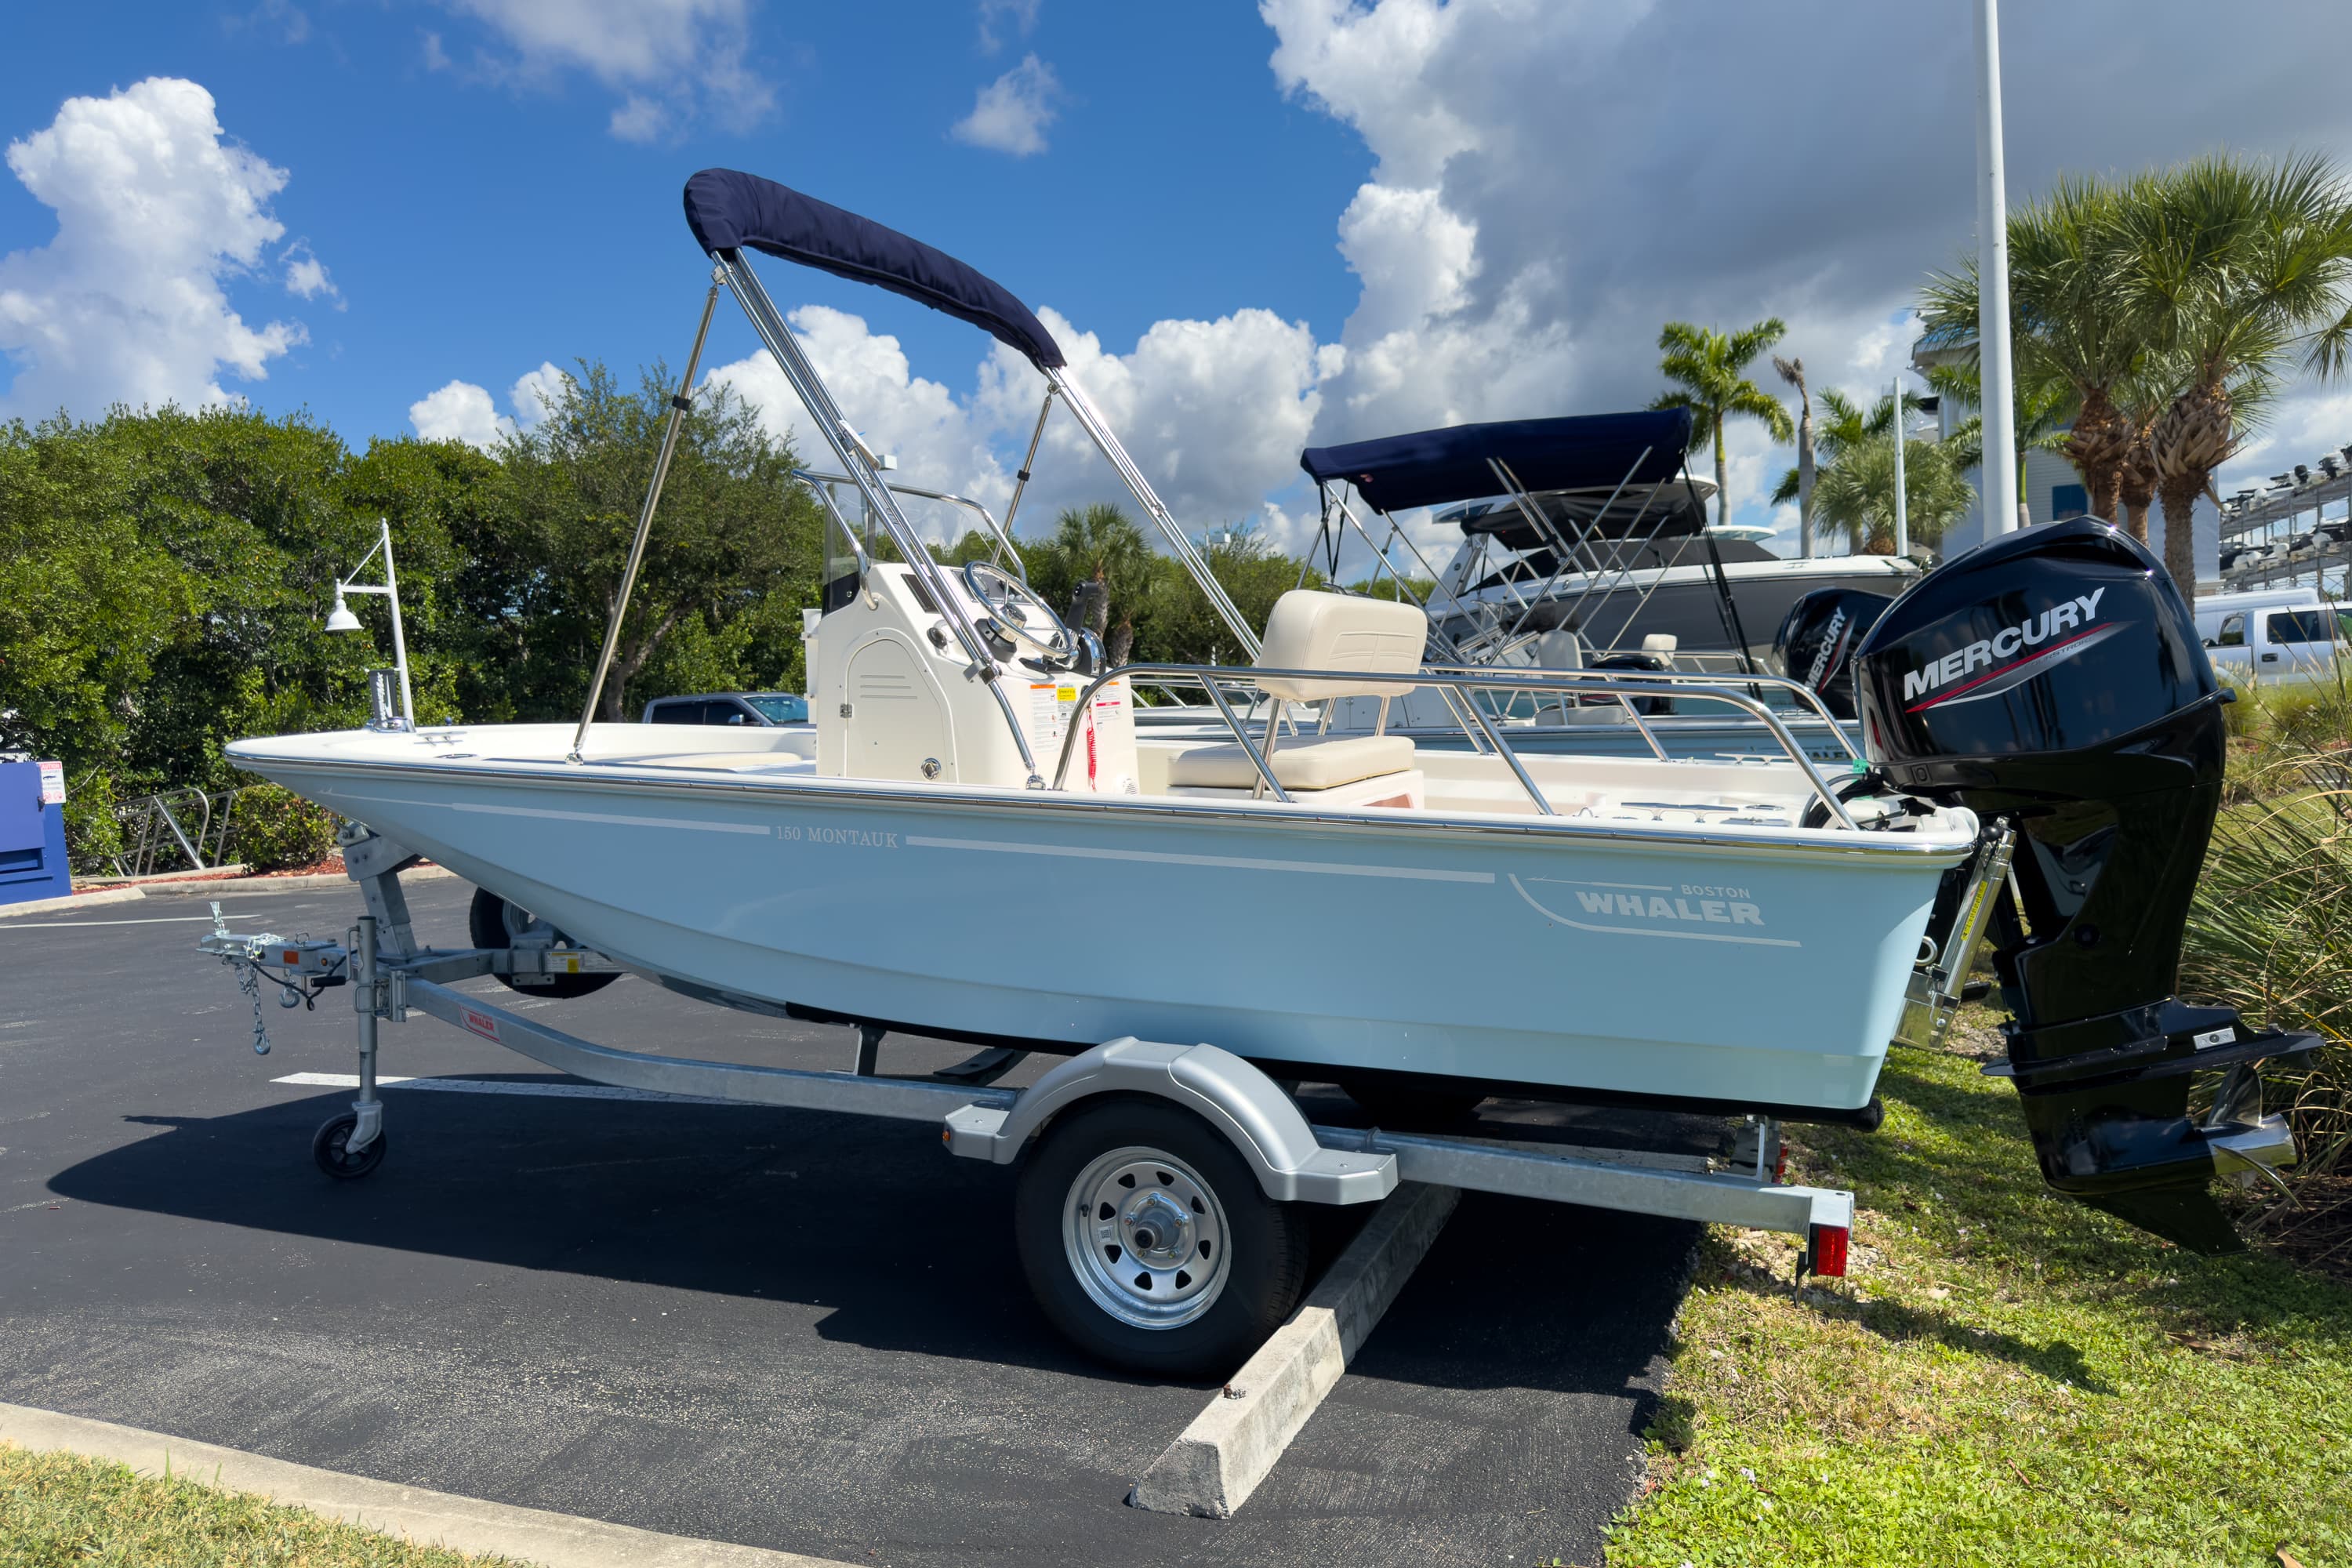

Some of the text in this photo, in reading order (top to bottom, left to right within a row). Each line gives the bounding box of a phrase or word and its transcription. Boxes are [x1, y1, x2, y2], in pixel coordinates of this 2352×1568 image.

[1804, 606, 1846, 691] MERCURY
[1904, 586, 2106, 702] MERCURY
[776, 826, 899, 848] 150 MONTAUK
[1575, 891, 1766, 926] WHALER
[1681, 884, 1751, 899] BOSTON
